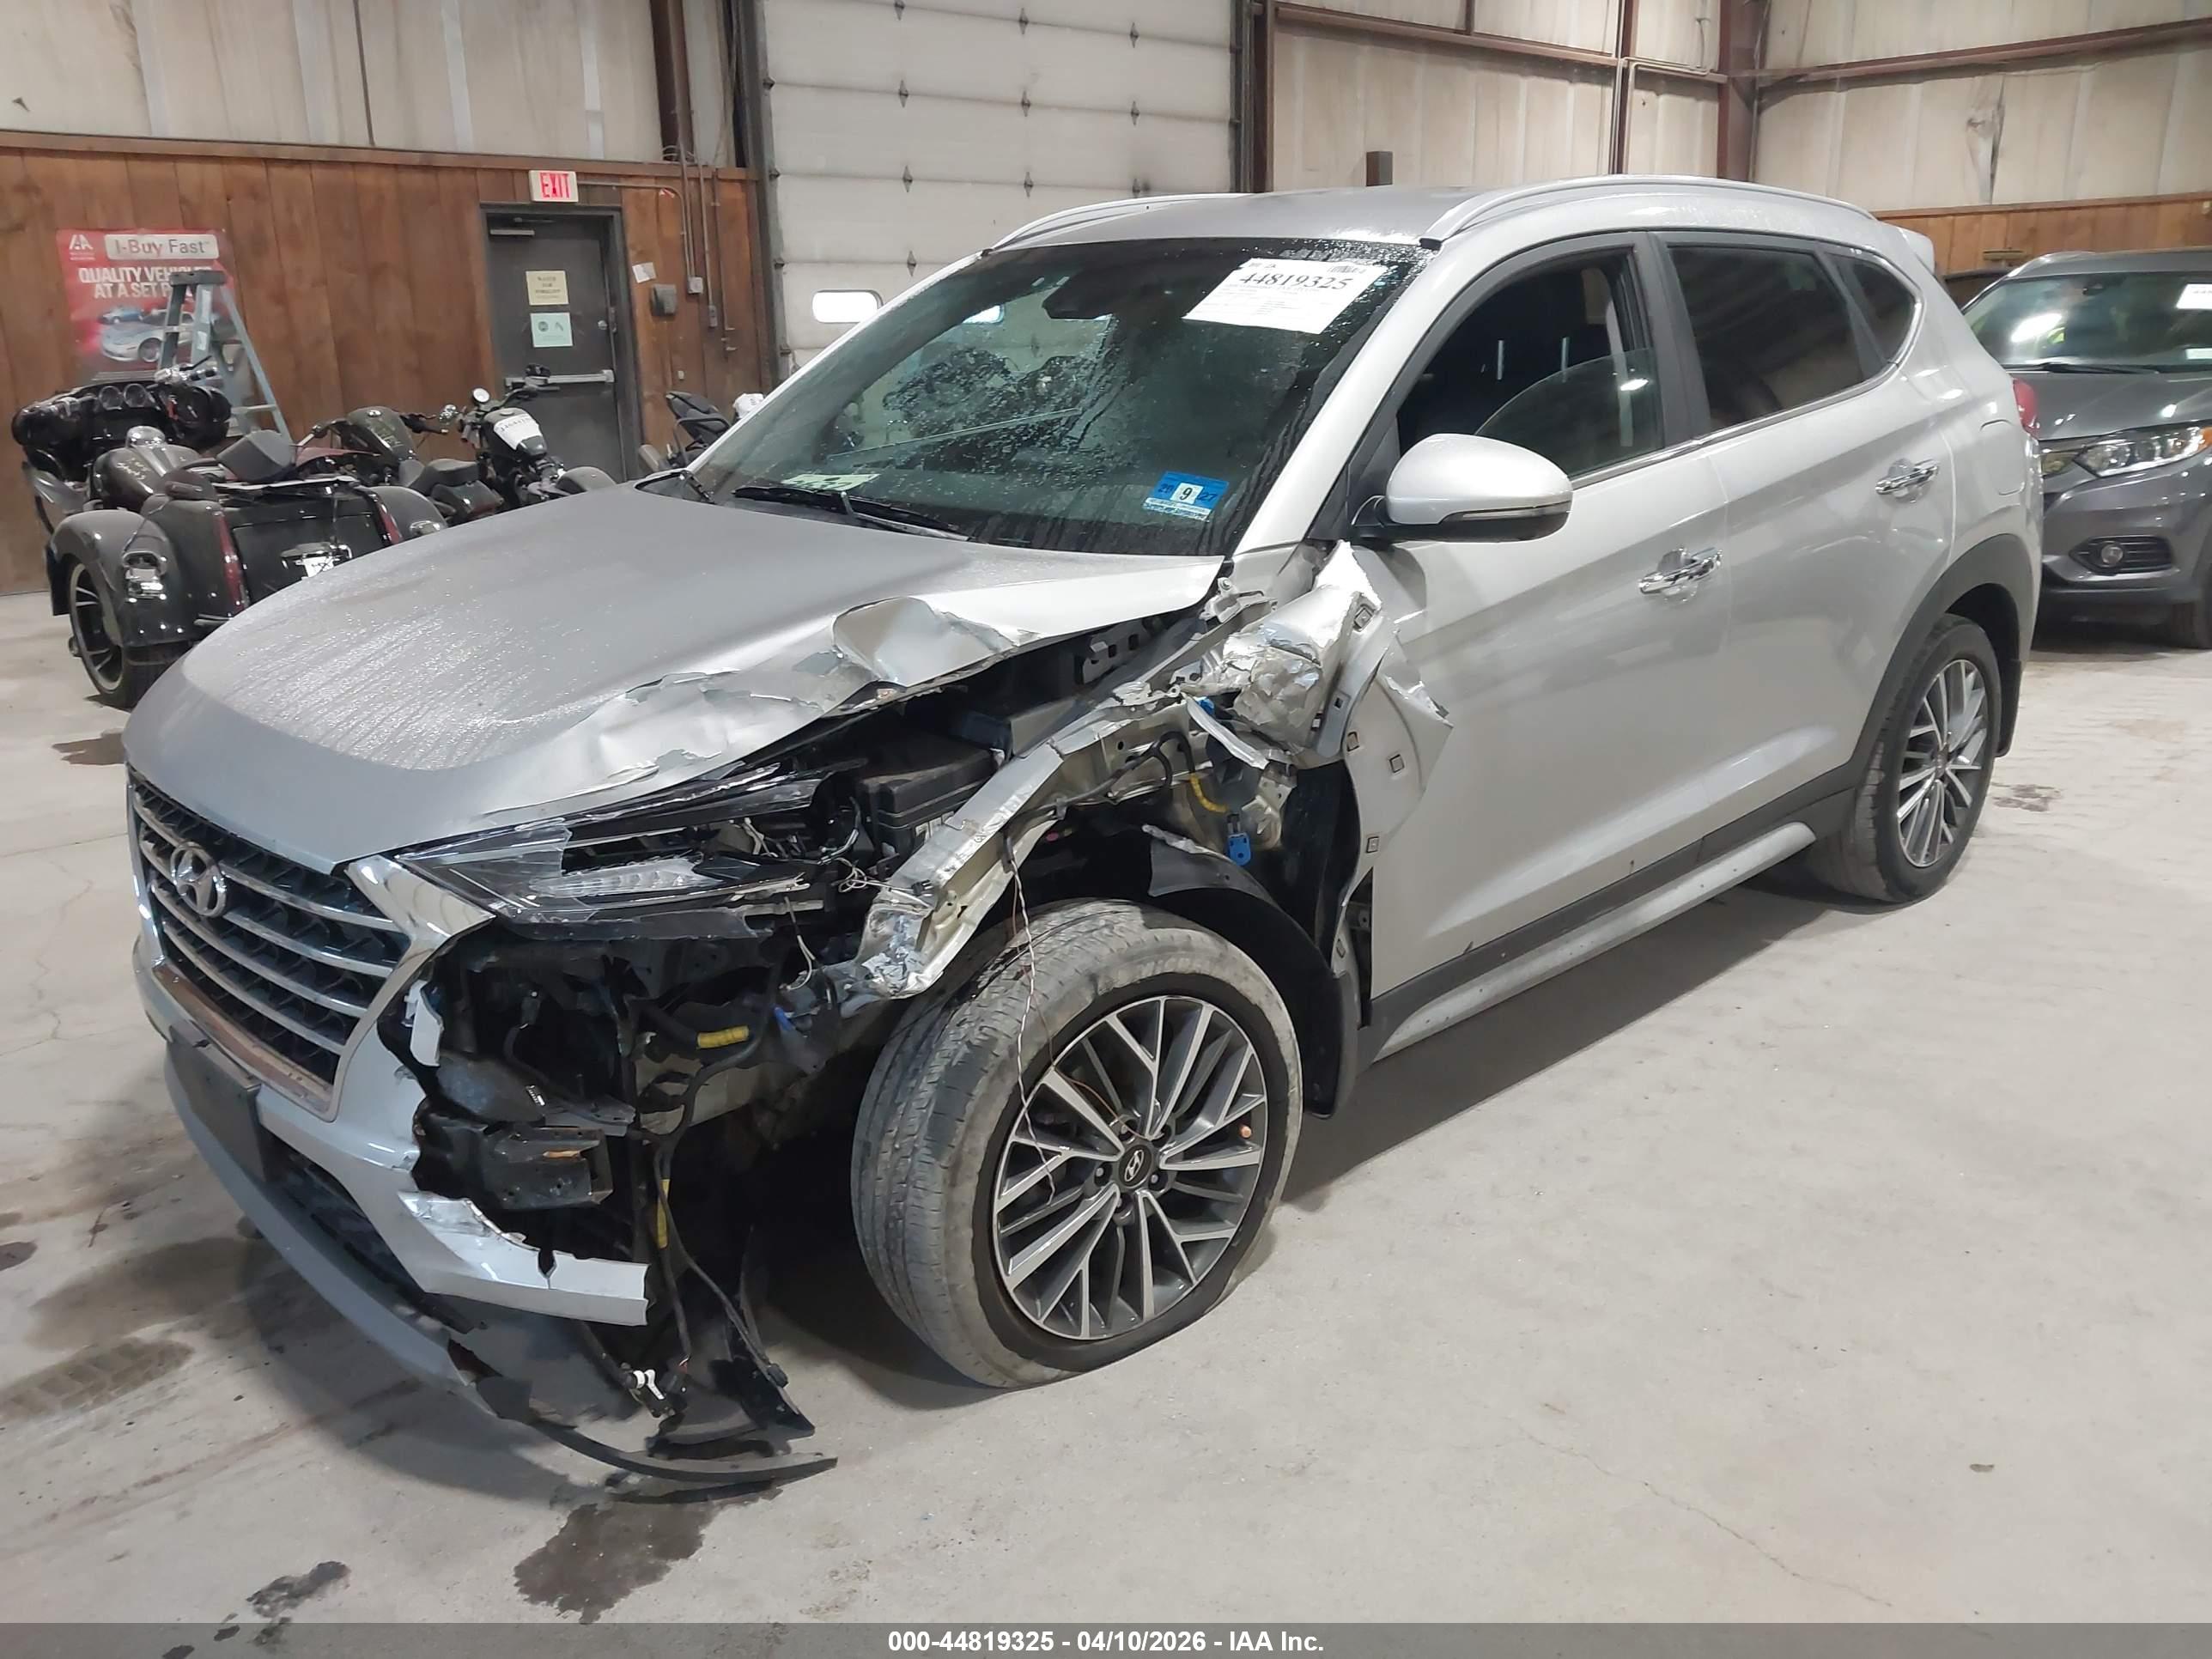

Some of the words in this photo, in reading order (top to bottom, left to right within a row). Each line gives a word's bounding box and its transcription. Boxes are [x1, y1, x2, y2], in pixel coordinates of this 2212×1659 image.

[539, 173, 569, 198] EXIT
[114, 238, 163, 257] I-Buy
[78, 266, 142, 283] QUALITY
[1239, 272, 1354, 290] 44819325
[94, 283, 113, 299] AT
[117, 283, 130, 298] A
[131, 283, 158, 298] SET
[1179, 487, 1193, 501] 9
